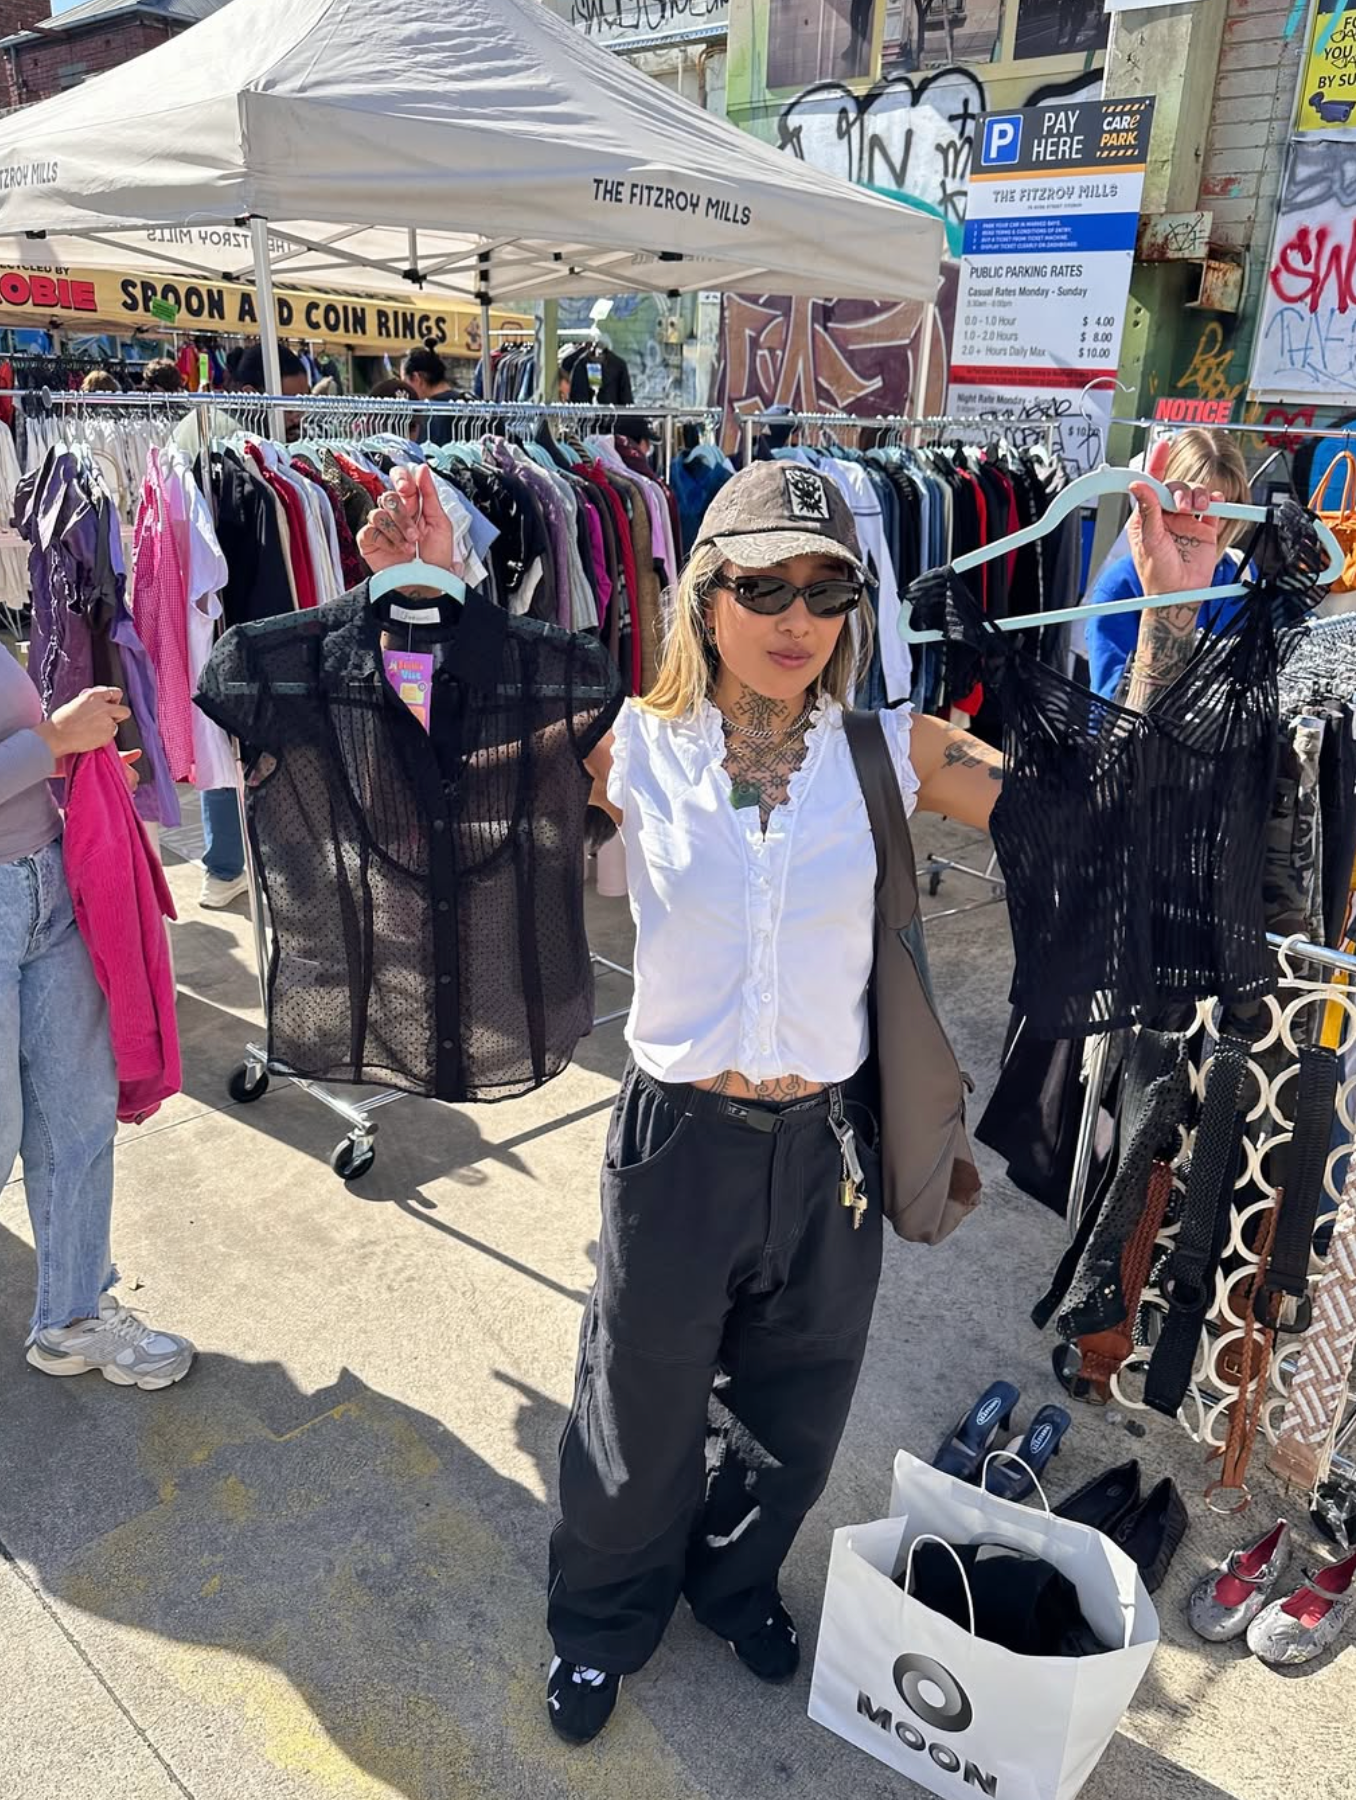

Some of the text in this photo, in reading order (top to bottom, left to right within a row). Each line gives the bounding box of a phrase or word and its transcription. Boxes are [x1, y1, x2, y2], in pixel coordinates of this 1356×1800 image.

[1324, 45, 1353, 61] YOU
[1318, 74, 1337, 89] BY
[1043, 110, 1080, 135] PAY
[989, 122, 1014, 158] P
[1100, 131, 1137, 147] PARK
[1031, 135, 1084, 162] HERE
[31, 161, 58, 185] MILLS
[593, 177, 752, 226] THE FITZROY MILLS
[992, 183, 1119, 204] THE FITZROY MILLS
[969, 264, 1084, 279] PUBLIC PARKING RATES
[968, 287, 993, 298] Casual
[995, 287, 1017, 297] Rates
[1018, 287, 1050, 299] Monday
[1057, 286, 1088, 298] Sunday
[120, 278, 226, 321] SPOON
[237, 292, 294, 327] AD
[304, 301, 368, 336] COIN
[376, 308, 448, 344] RINGS
[964, 315, 978, 326] 0.0
[985, 315, 998, 326] 1.0
[998, 315, 1017, 326] Hour
[1082, 316, 1115, 327] $ 4.00
[963, 330, 976, 341] 1.0
[982, 330, 996, 341] 2.0
[996, 330, 1019, 342] Hours
[1080, 332, 1113, 343] $ 8.00
[961, 345, 974, 356] 2.0
[985, 345, 1008, 356] Hours
[1009, 345, 1028, 358] Daily
[1029, 346, 1047, 358] Max
[1078, 347, 1111, 359] $ 10.00
[1155, 397, 1233, 424] NOTICE
[1067, 426, 1074, 436] $
[857, 1690, 998, 1798] MOON
